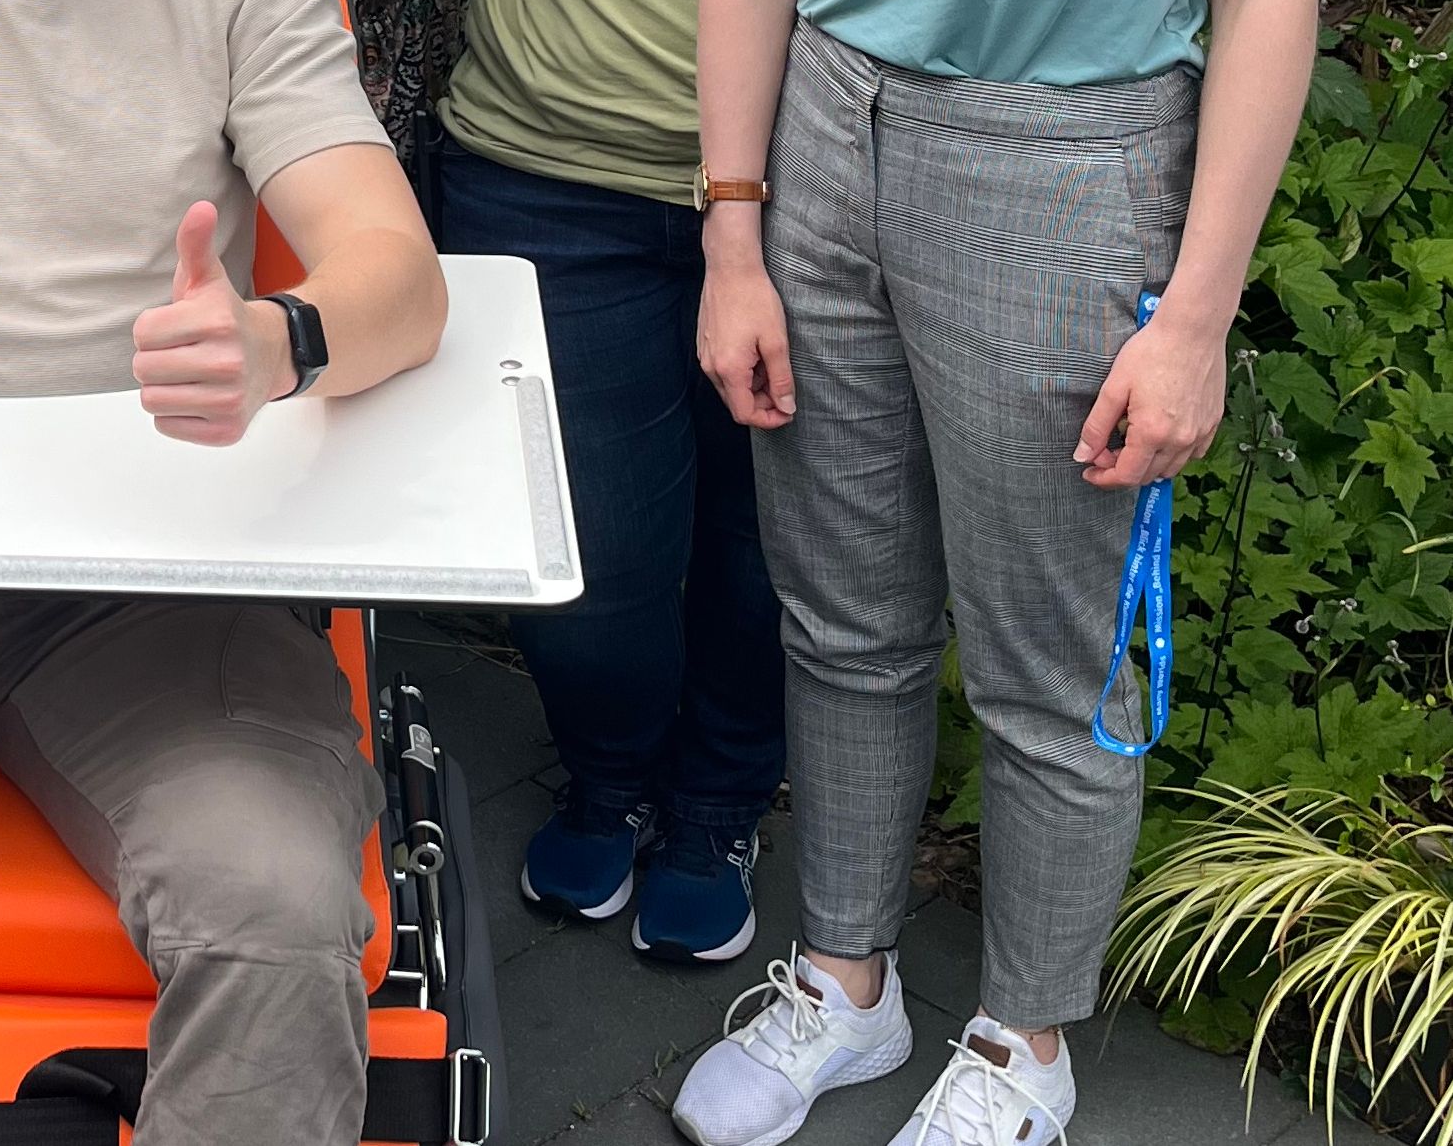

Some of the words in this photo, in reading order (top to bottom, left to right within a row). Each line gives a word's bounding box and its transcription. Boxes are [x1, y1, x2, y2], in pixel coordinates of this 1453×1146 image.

[1143, 486, 1161, 525] Mission
[1128, 553, 1144, 584] hinter
[1154, 594, 1164, 633] Mission
